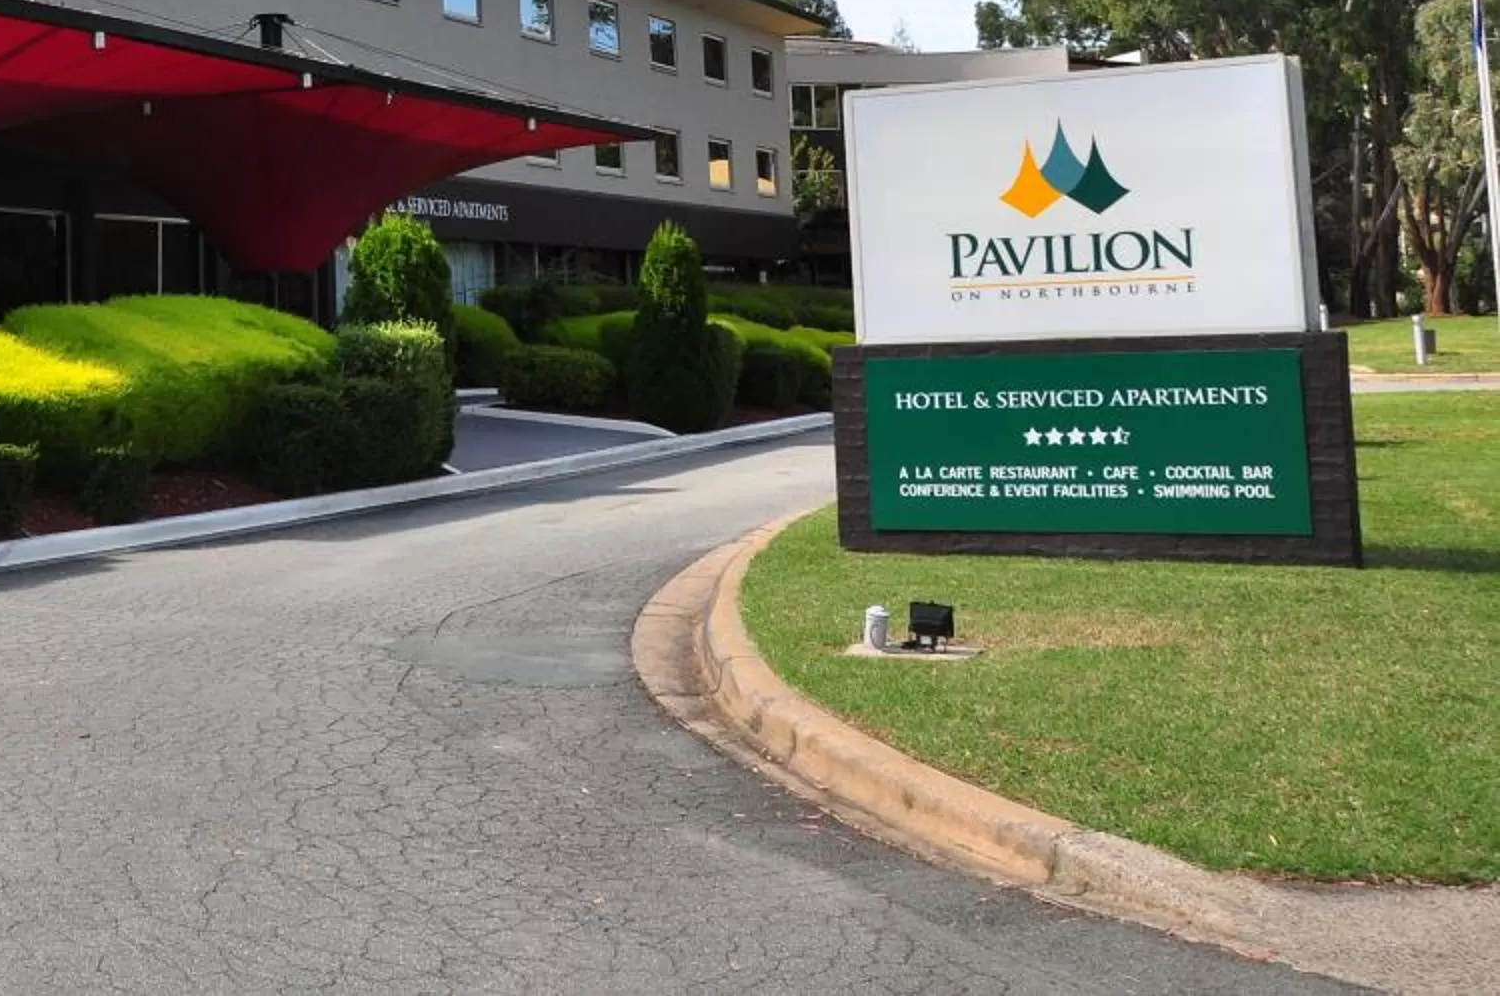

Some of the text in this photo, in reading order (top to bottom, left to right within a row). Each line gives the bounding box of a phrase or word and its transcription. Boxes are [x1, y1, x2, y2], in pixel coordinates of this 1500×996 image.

[407, 196, 451, 217] SERVICED
[452, 200, 509, 221] APARTMENTS
[947, 228, 1194, 278] PAVILION
[951, 283, 1196, 302] ON NORTHBOURNE
[895, 386, 1268, 409] HOTEL & SERVICED APARTMENTS
[899, 465, 1273, 479] A LA CARTE RESTAURANT CAFE COCKTAIL BAR
[899, 484, 1275, 499] CONFERENCE & EVENT FACILITIES SWIMMING POOL
